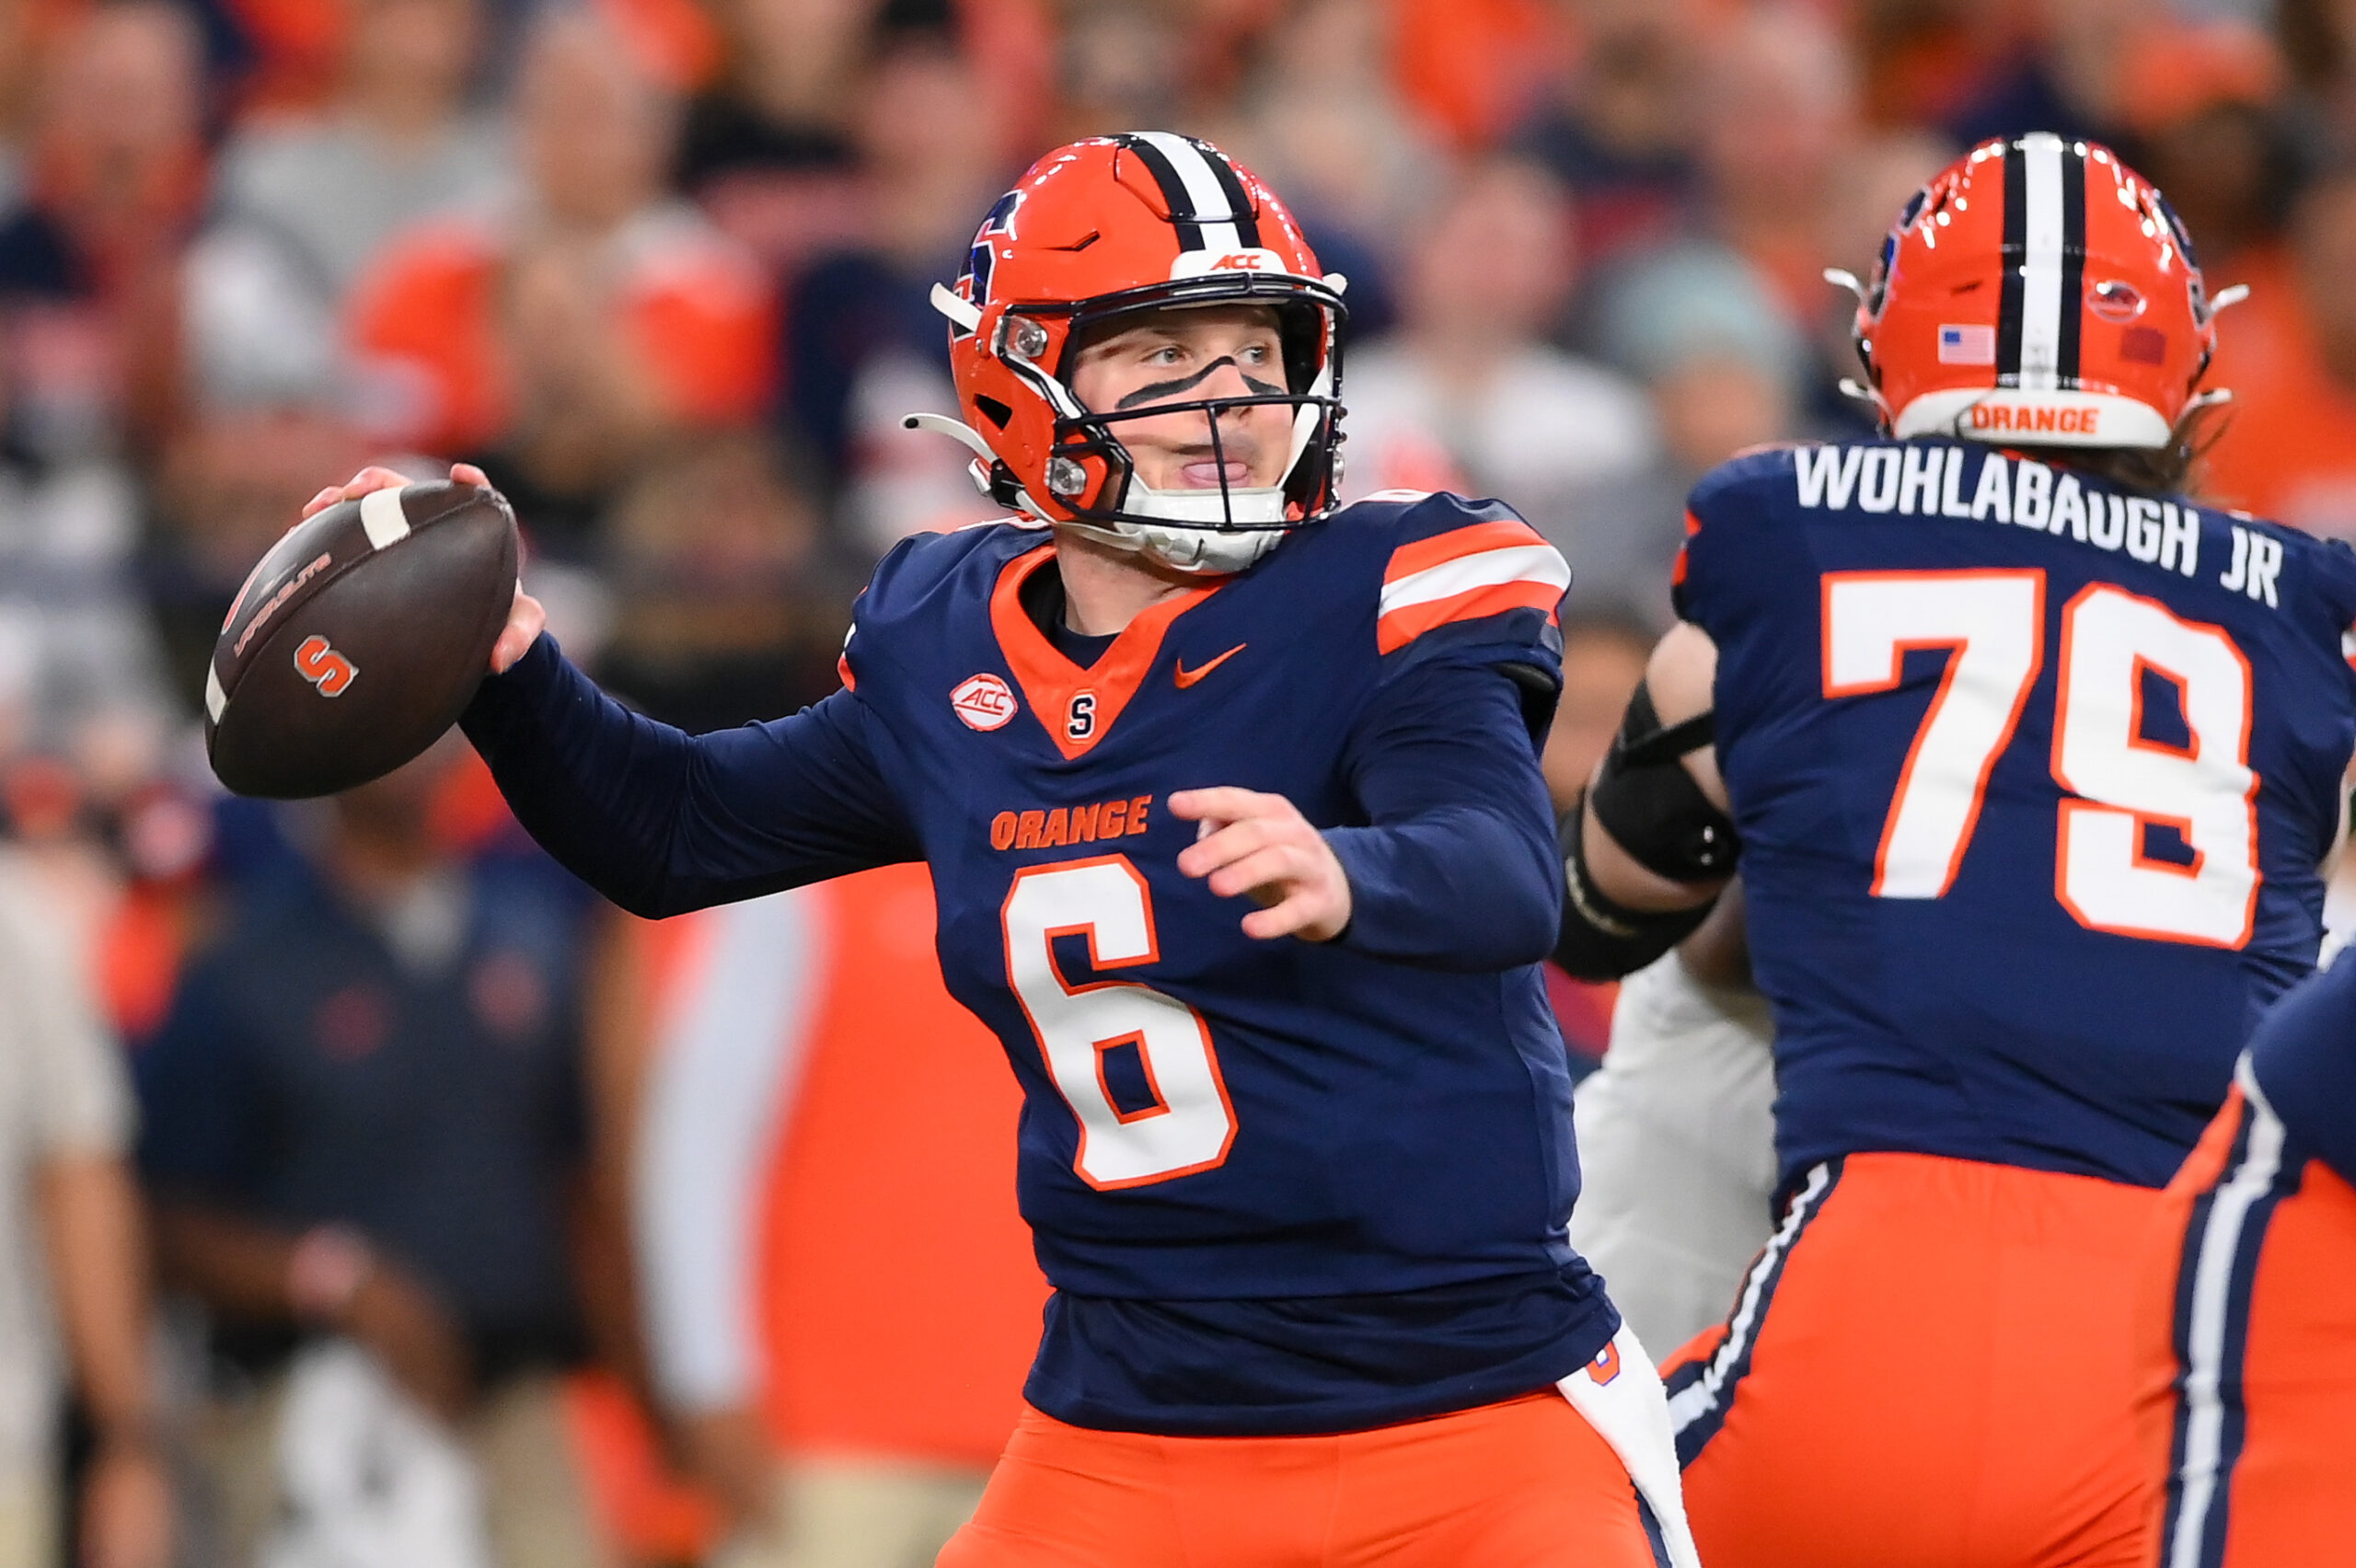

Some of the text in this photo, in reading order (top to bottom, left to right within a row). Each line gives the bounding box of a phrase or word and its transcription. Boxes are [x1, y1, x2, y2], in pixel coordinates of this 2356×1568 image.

[1209, 254, 1261, 271] ACC
[1971, 404, 2099, 433] ORANGE
[1794, 445, 2284, 609] WOHLABAUGH JR
[294, 634, 355, 698] S
[961, 687, 1008, 711] ACC
[1067, 692, 1096, 739] S
[1819, 567, 2263, 951] 79
[990, 794, 1153, 850] ORANGE
[999, 852, 1240, 1193] 6
